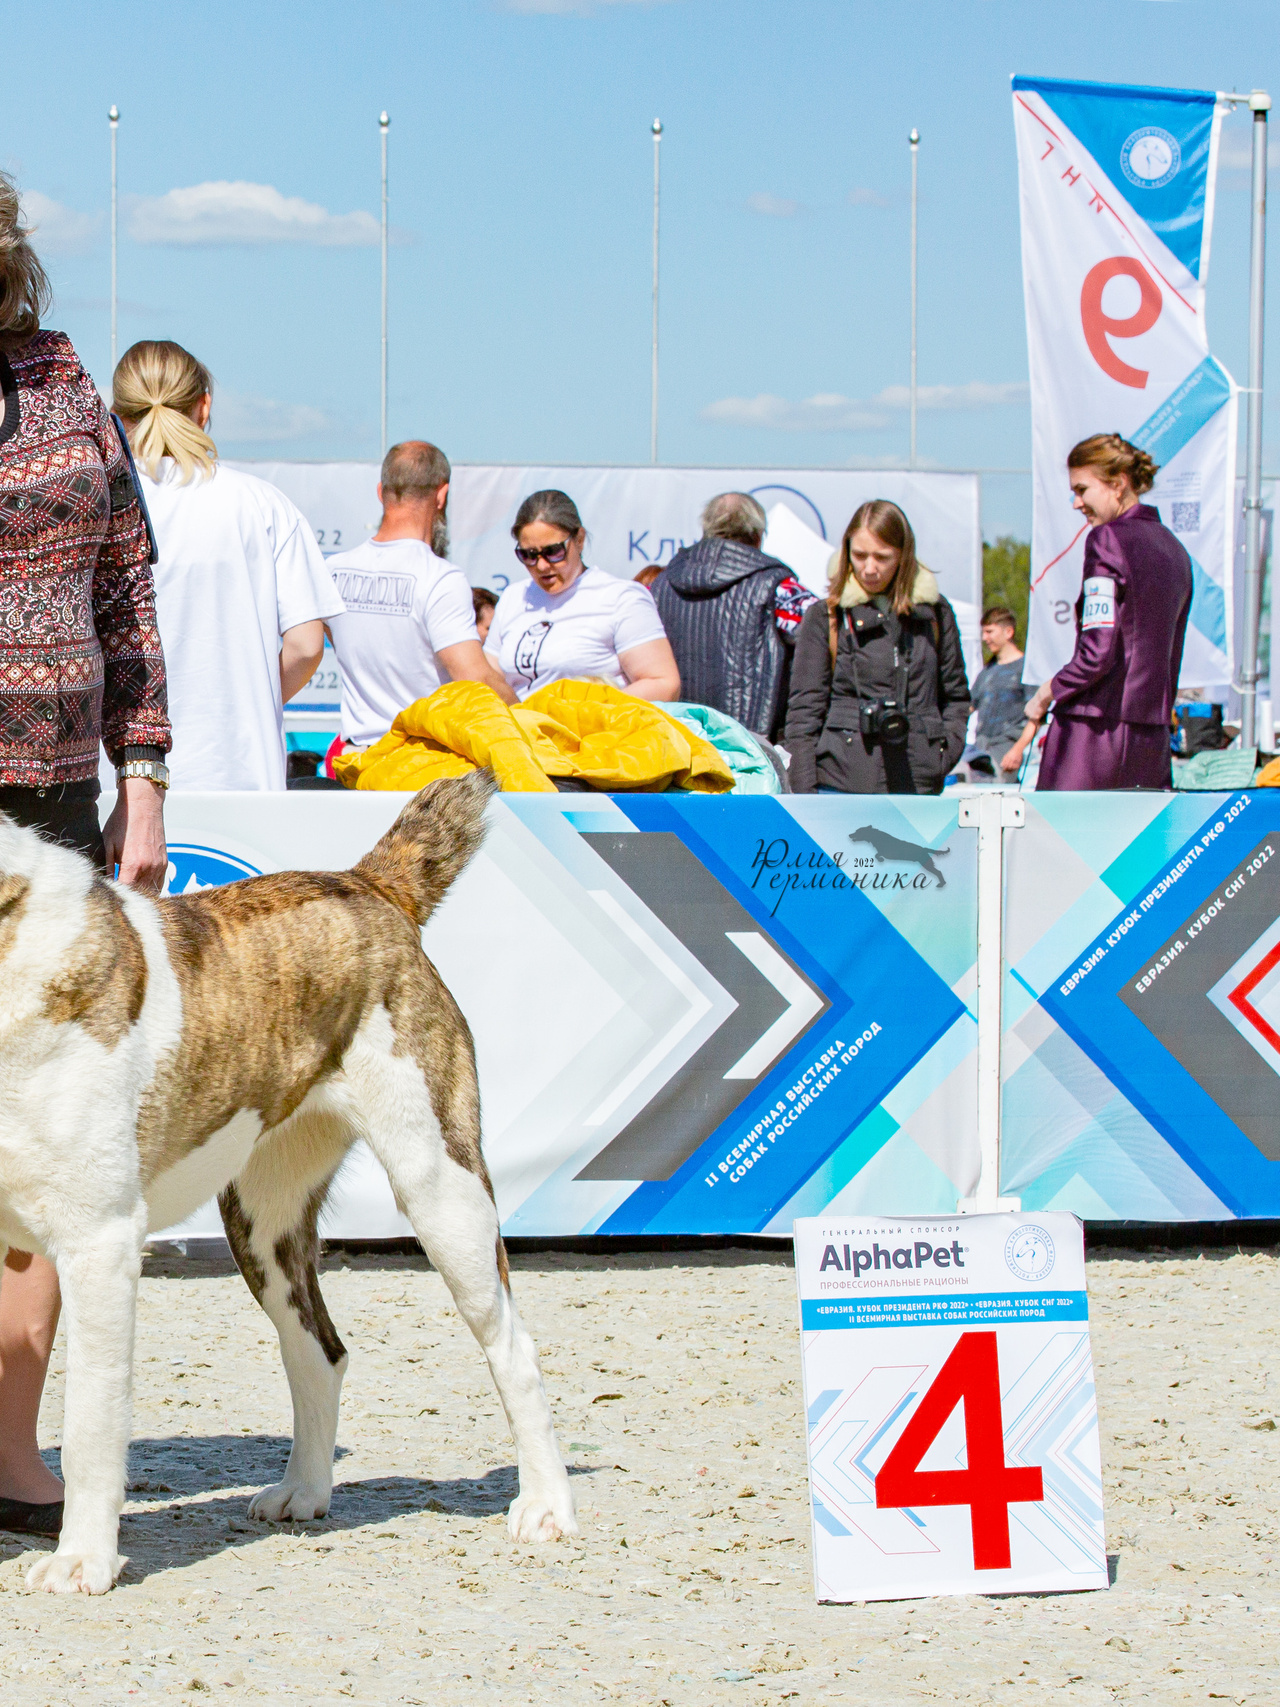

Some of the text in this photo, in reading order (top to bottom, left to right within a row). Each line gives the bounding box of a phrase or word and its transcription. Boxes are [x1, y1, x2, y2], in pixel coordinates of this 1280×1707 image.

[1060, 794, 1252, 996] ЕВРАЗИЯ. КУБОК ПРЕЗИДЕНТА РКФ 2022
[1134, 845, 1276, 994] ЕВРАЗИЯ. КУБОК СНГ 2022
[718, 1101, 787, 1174] ВСЕМИРНАЯ
[785, 1040, 846, 1102] ВЫСТАВКА
[729, 1021, 883, 1183] СОБАК РОССИЙСКИХ ПОРОД
[819, 1240, 965, 1278] AlphaPet
[822, 1225, 960, 1237] ГЕНЕРАЛЬНЫЙ СПОНСОР
[820, 1277, 969, 1290] ПРОФЕССИОНАЛЬНЫЕ РАЦИОНЫ
[856, 1314, 901, 1323] ВСЕМИРНАЯ
[902, 1312, 941, 1321] ВЫСТАВКА
[943, 1311, 968, 1320] СОБАК
[969, 1309, 1018, 1319] РОССИЙСКИХ
[1019, 1309, 1046, 1317] ПОРОД
[857, 1305, 881, 1313] КУБОК
[883, 1302, 931, 1312] ПРЕЗИДЕНТА
[932, 1302, 948, 1310] РКФ
[1015, 1299, 1039, 1307] КУБОК
[1041, 1298, 1055, 1306] СНГ
[875, 1331, 1044, 1571] 4
